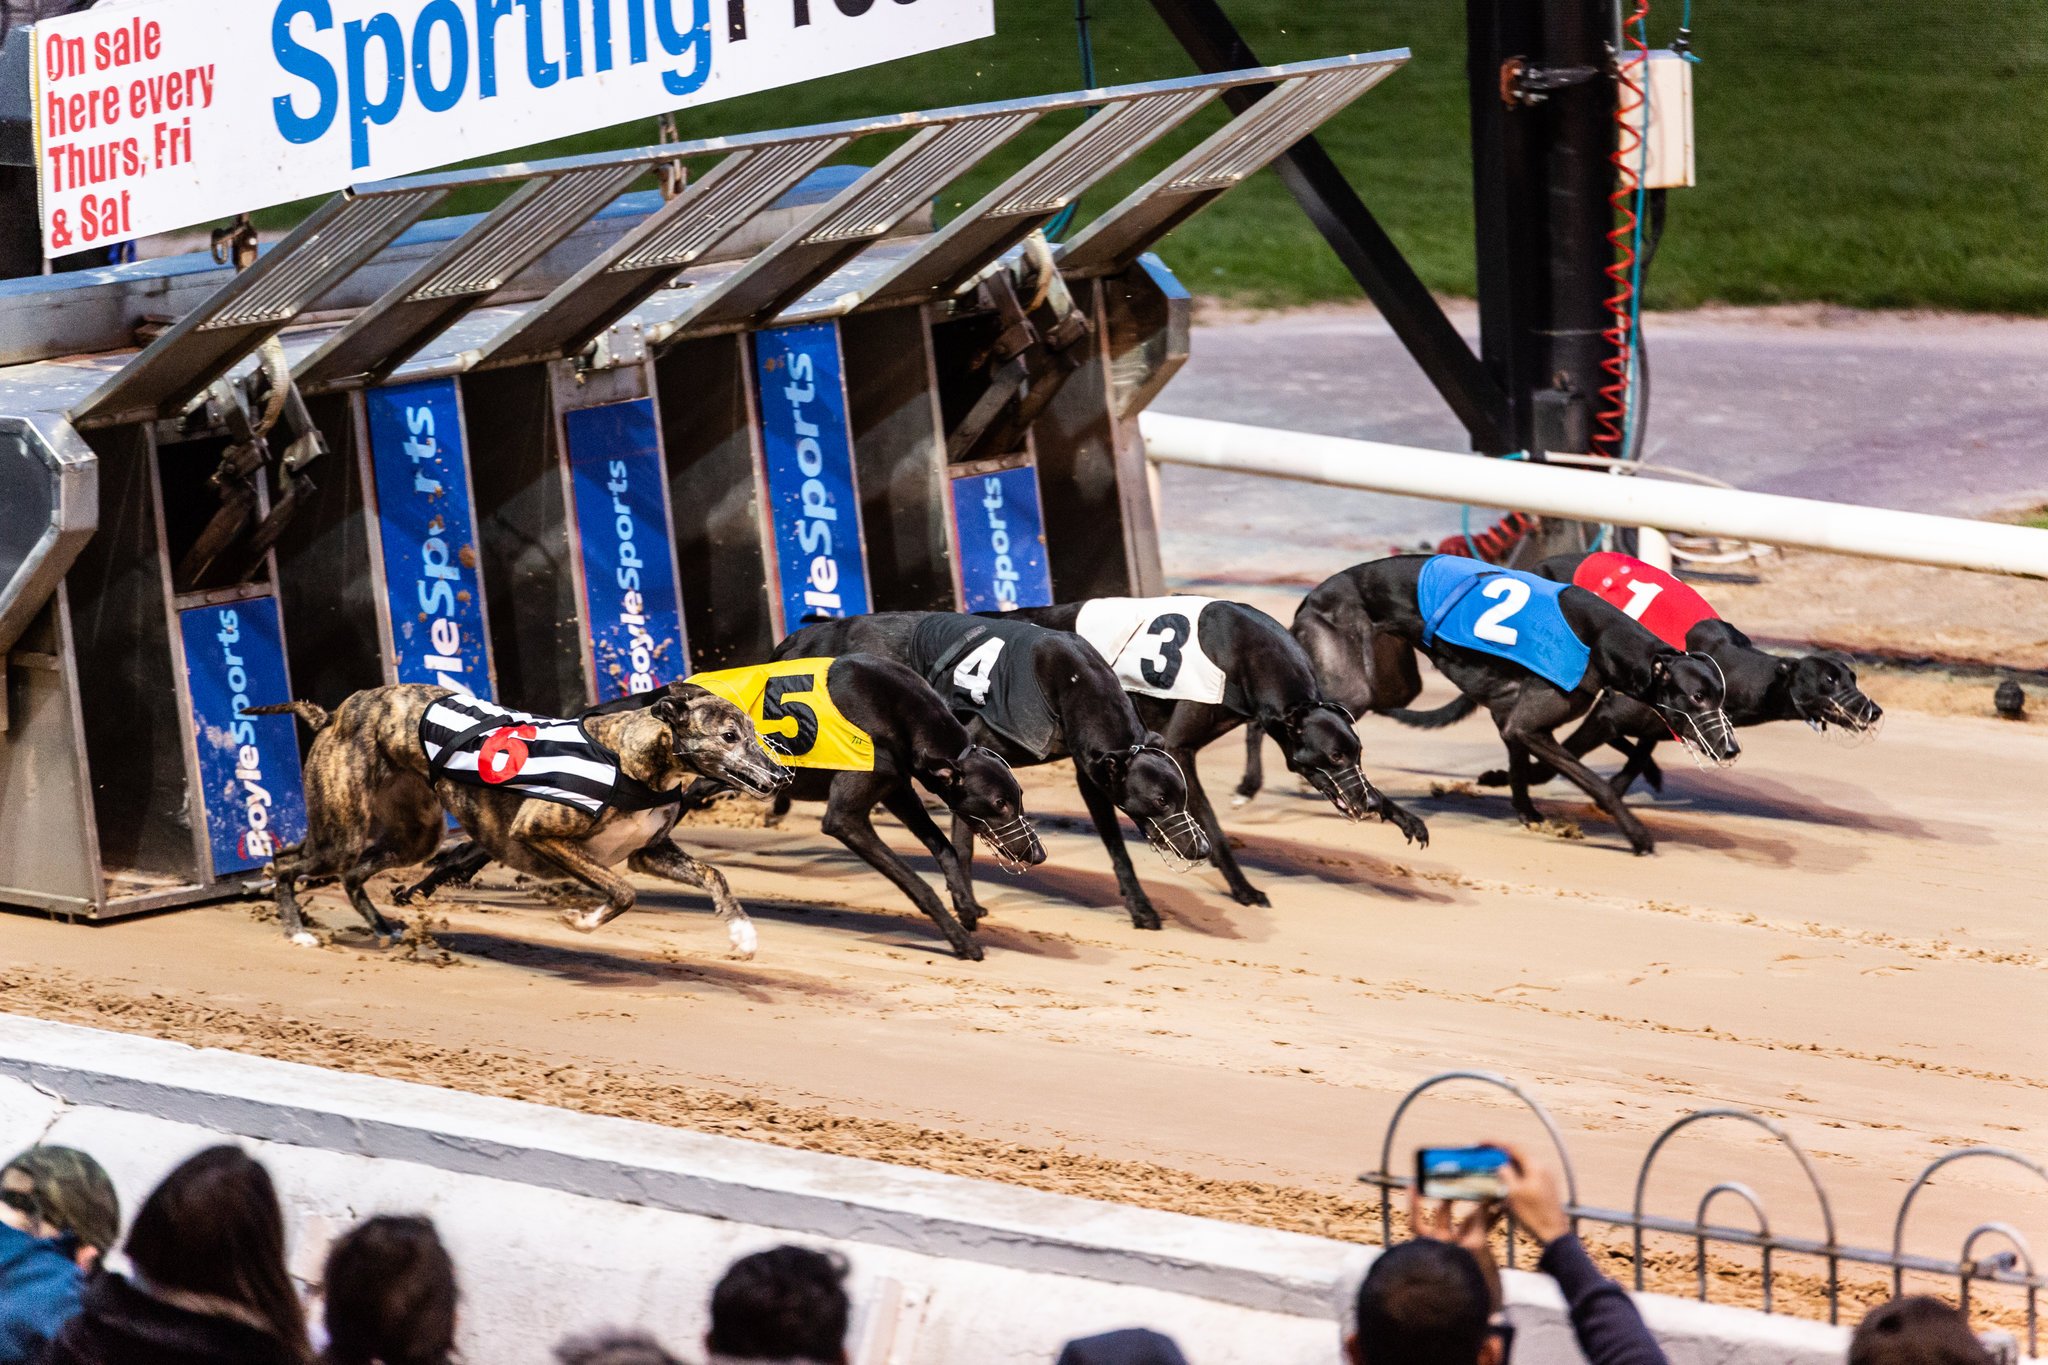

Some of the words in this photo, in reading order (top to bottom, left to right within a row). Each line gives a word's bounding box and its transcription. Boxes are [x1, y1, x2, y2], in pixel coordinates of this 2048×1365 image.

[46, 33, 86, 82] On
[94, 16, 162, 71] sale
[47, 85, 121, 138] here
[129, 63, 215, 119] every
[47, 137, 147, 193] Thurs,
[154, 116, 192, 170] Fri
[51, 208, 73, 249] &
[80, 189, 132, 242] Sat
[607, 459, 655, 695] BoyleSports
[982, 477, 1020, 611] Sports
[1473, 577, 1531, 646] 2
[1626, 578, 1664, 621] 1
[953, 636, 1006, 706] 4
[1140, 612, 1191, 690] 3
[217, 609, 273, 857] BoyleSports
[762, 673, 819, 756] 5
[477, 723, 537, 785] 6
